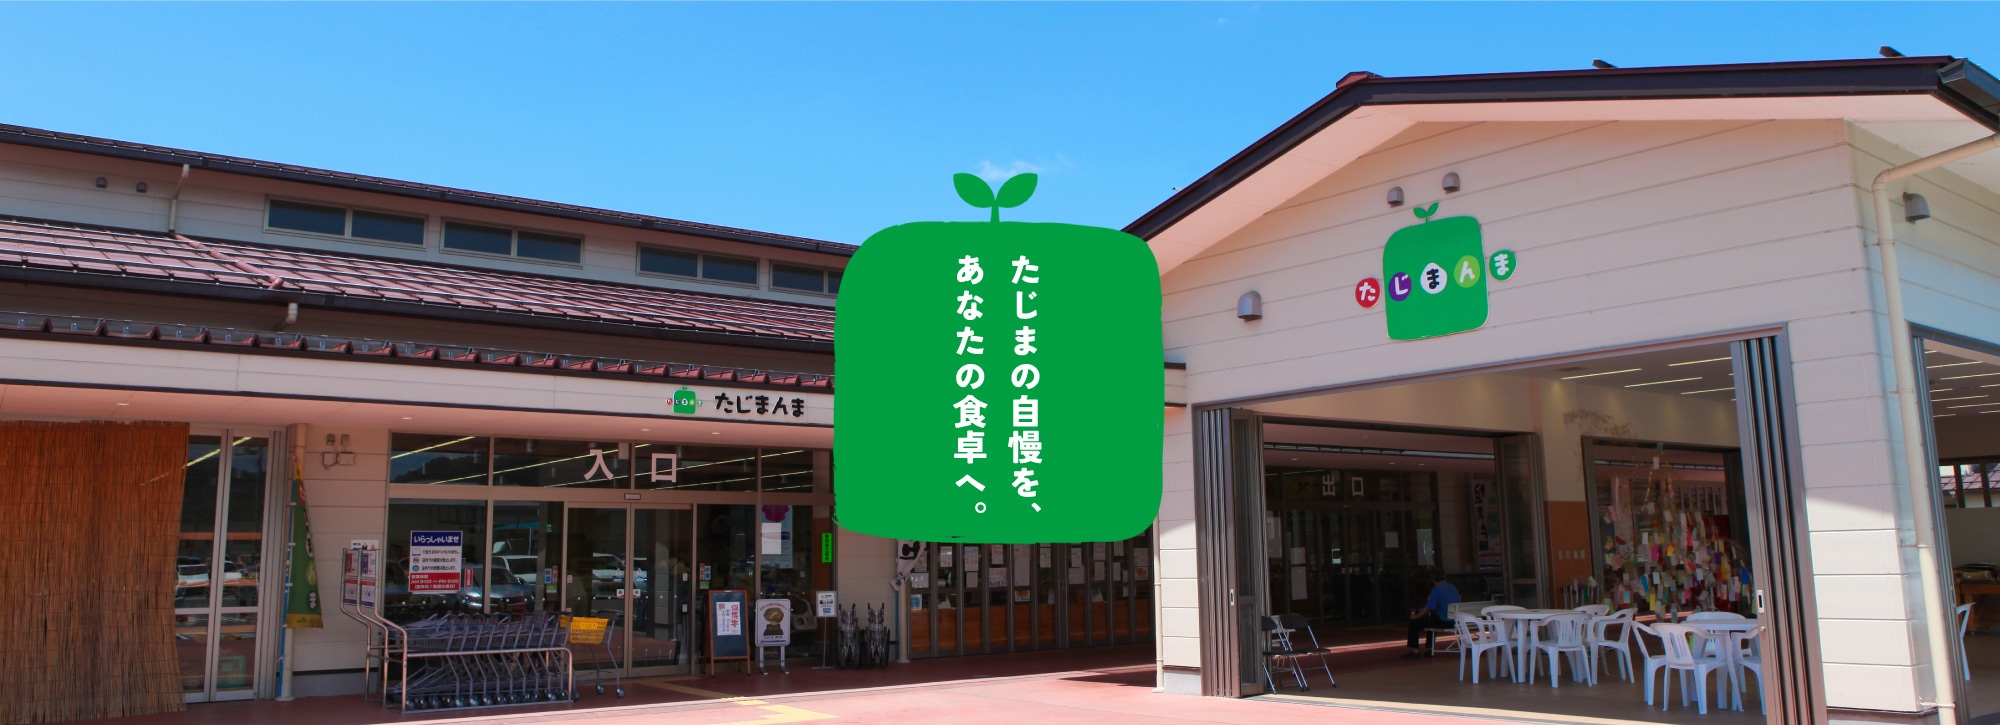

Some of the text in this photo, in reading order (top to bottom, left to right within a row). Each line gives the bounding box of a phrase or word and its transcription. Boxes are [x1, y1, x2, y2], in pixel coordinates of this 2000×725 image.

[1359, 254, 1509, 302] たじまんま
[714, 392, 805, 418] たじまんま
[583, 449, 677, 483] 入口
[1322, 473, 1364, 497] 出口
[413, 535, 460, 543] いらっしゃいませ
